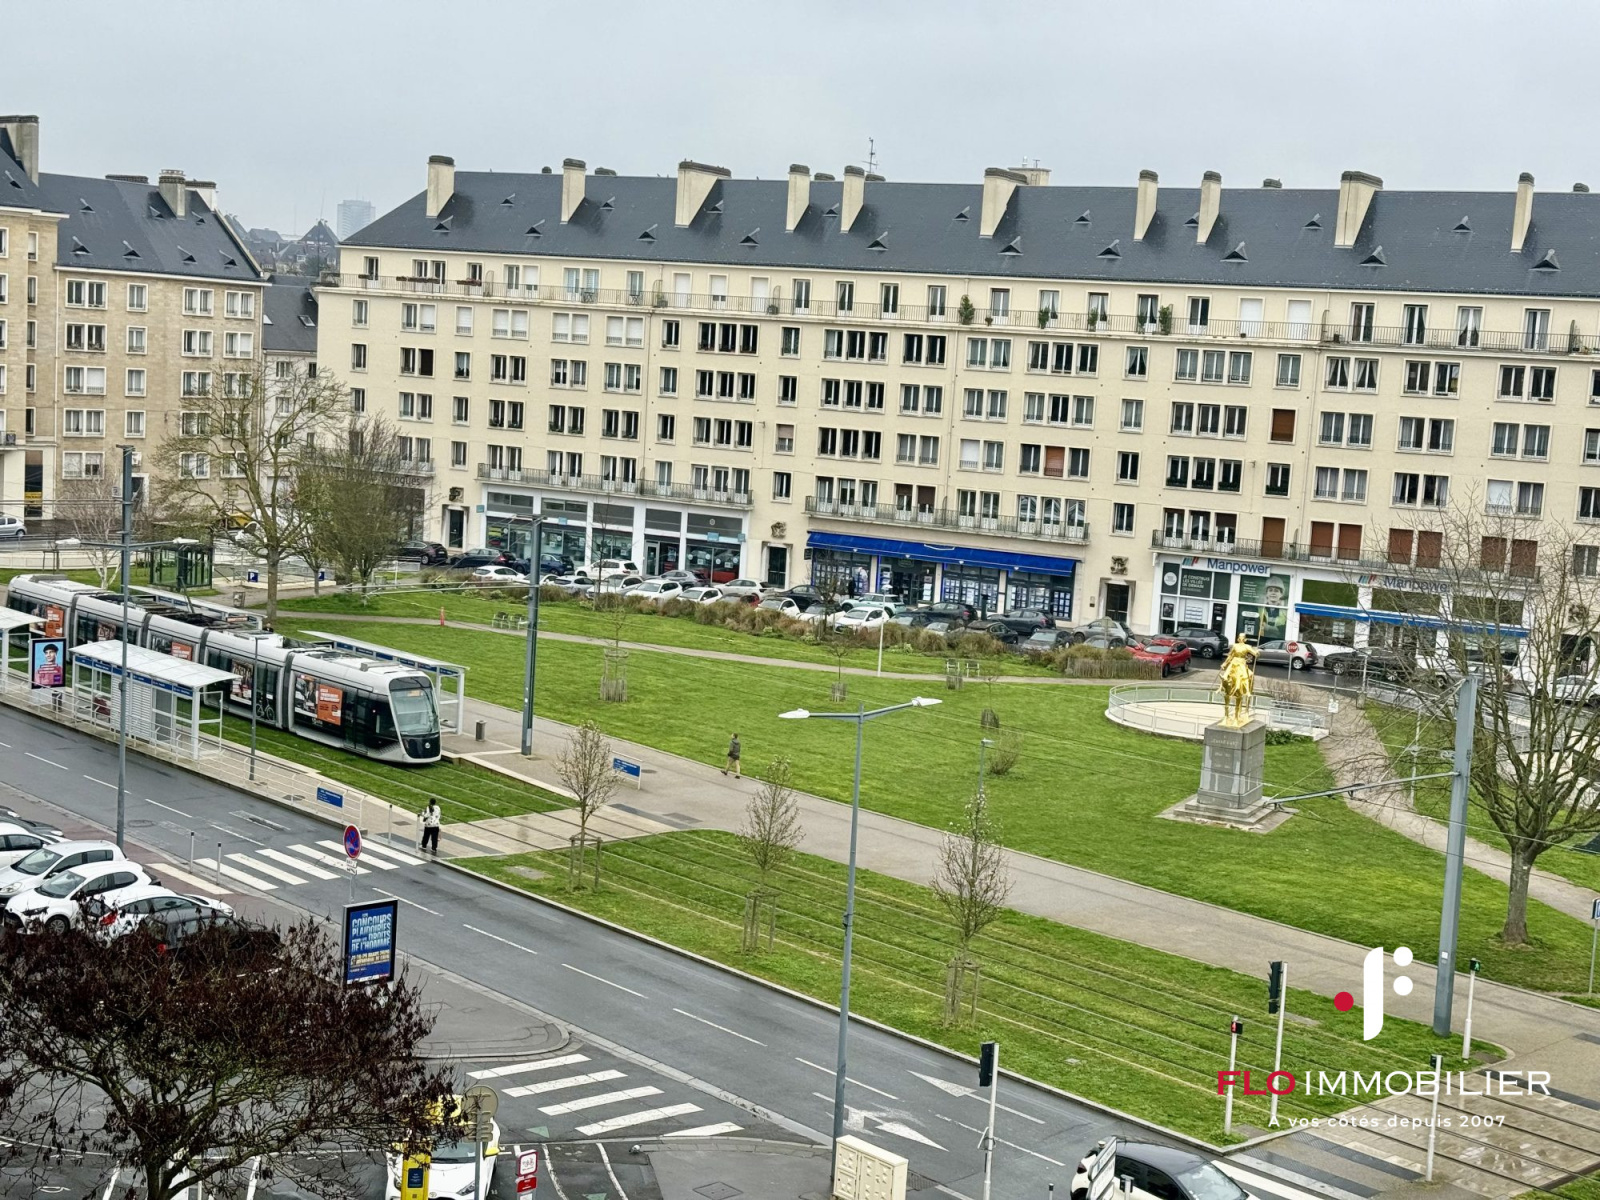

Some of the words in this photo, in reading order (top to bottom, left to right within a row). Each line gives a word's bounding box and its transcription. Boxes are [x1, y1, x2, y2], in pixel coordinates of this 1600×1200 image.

[1207, 558, 1270, 574] Manpower
[1384, 576, 1450, 593] Manpowe
[352, 913, 392, 928] CONCOURS
[352, 922, 391, 937] PLAIDOIRIES
[368, 930, 391, 941] DROITS
[351, 942, 360, 953] DE
[360, 938, 391, 952] L'HOMME
